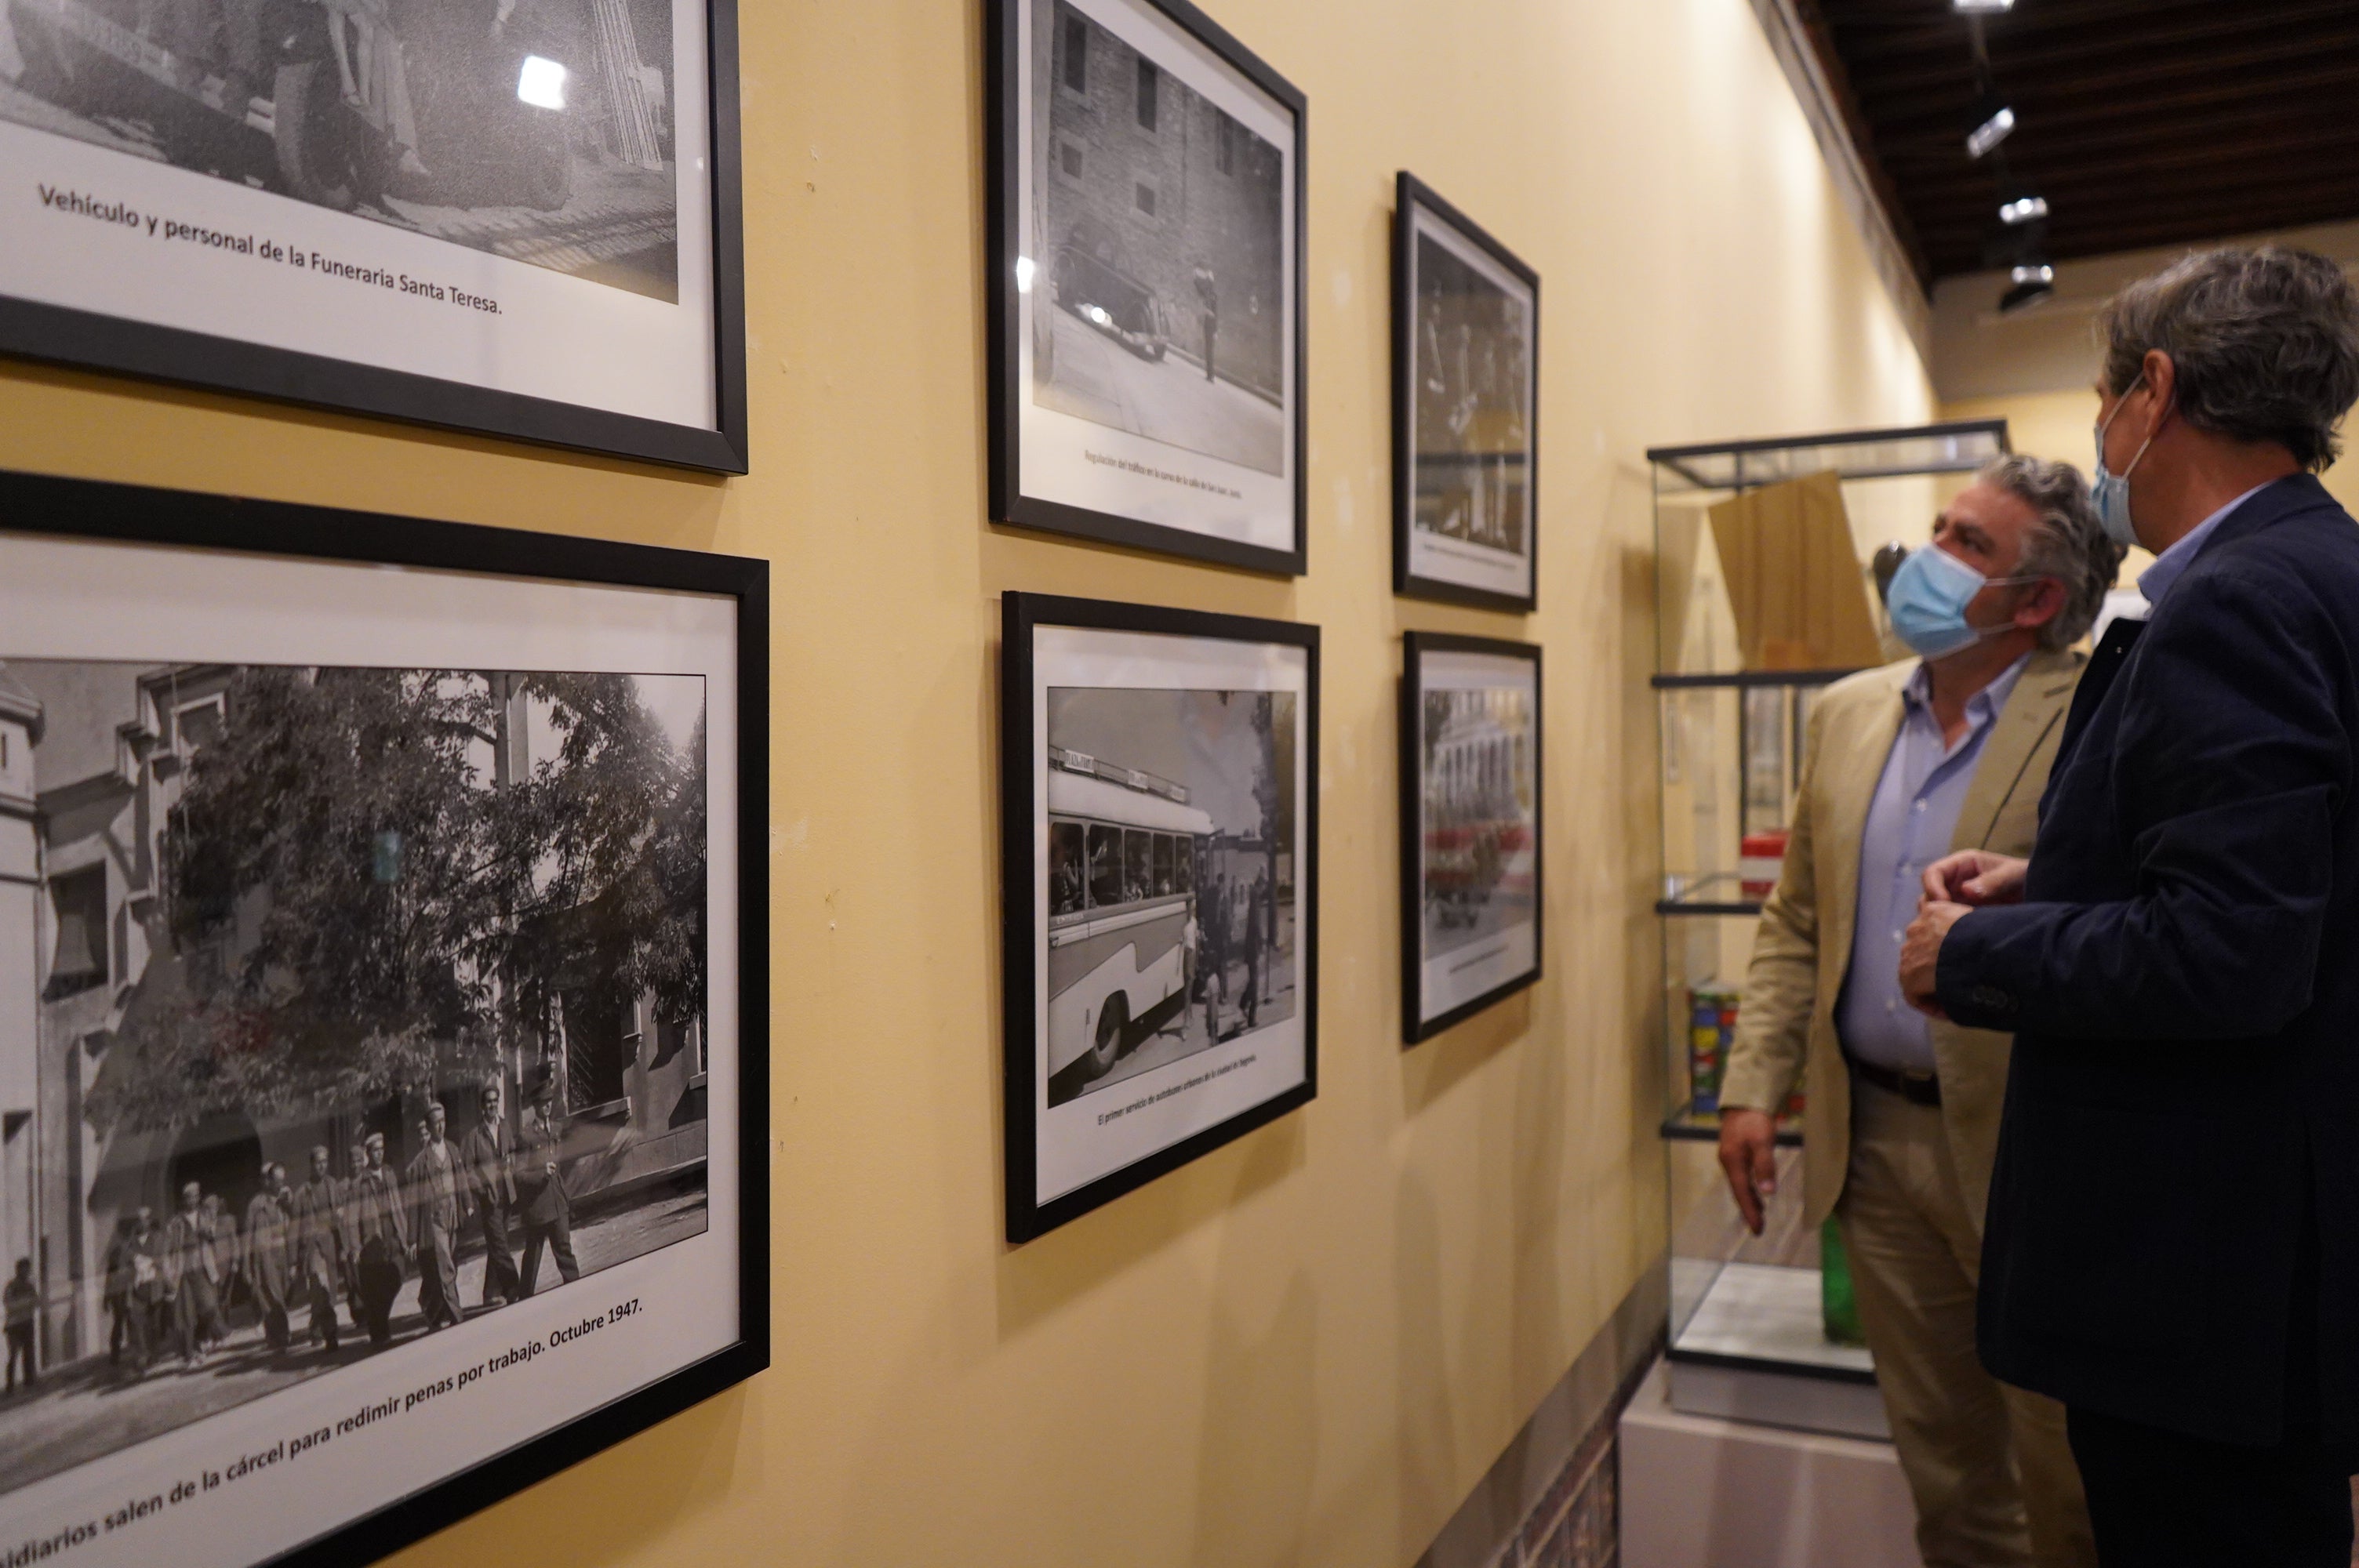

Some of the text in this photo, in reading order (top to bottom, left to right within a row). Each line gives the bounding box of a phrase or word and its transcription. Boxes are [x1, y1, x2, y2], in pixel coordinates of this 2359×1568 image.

[38, 183, 503, 315] Vehículo y personal de la Funeraria Santa Teresa.
[1098, 1114, 1103, 1126] El
[1105, 1108, 1125, 1126] primer
[1125, 1098, 1147, 1115] servicio
[1148, 1094, 1155, 1105] de
[104, 1493, 163, 1534] salen
[169, 1480, 196, 1506] de
[202, 1470, 220, 1492] la
[226, 1440, 285, 1482] cárcel
[289, 1425, 331, 1461] para
[336, 1396, 401, 1437] redimir
[405, 1377, 453, 1413] penas
[458, 1364, 485, 1390] por
[489, 1341, 546, 1374] trabajo.
[550, 1313, 605, 1348] Octubre
[608, 1298, 643, 1325] 1947.
